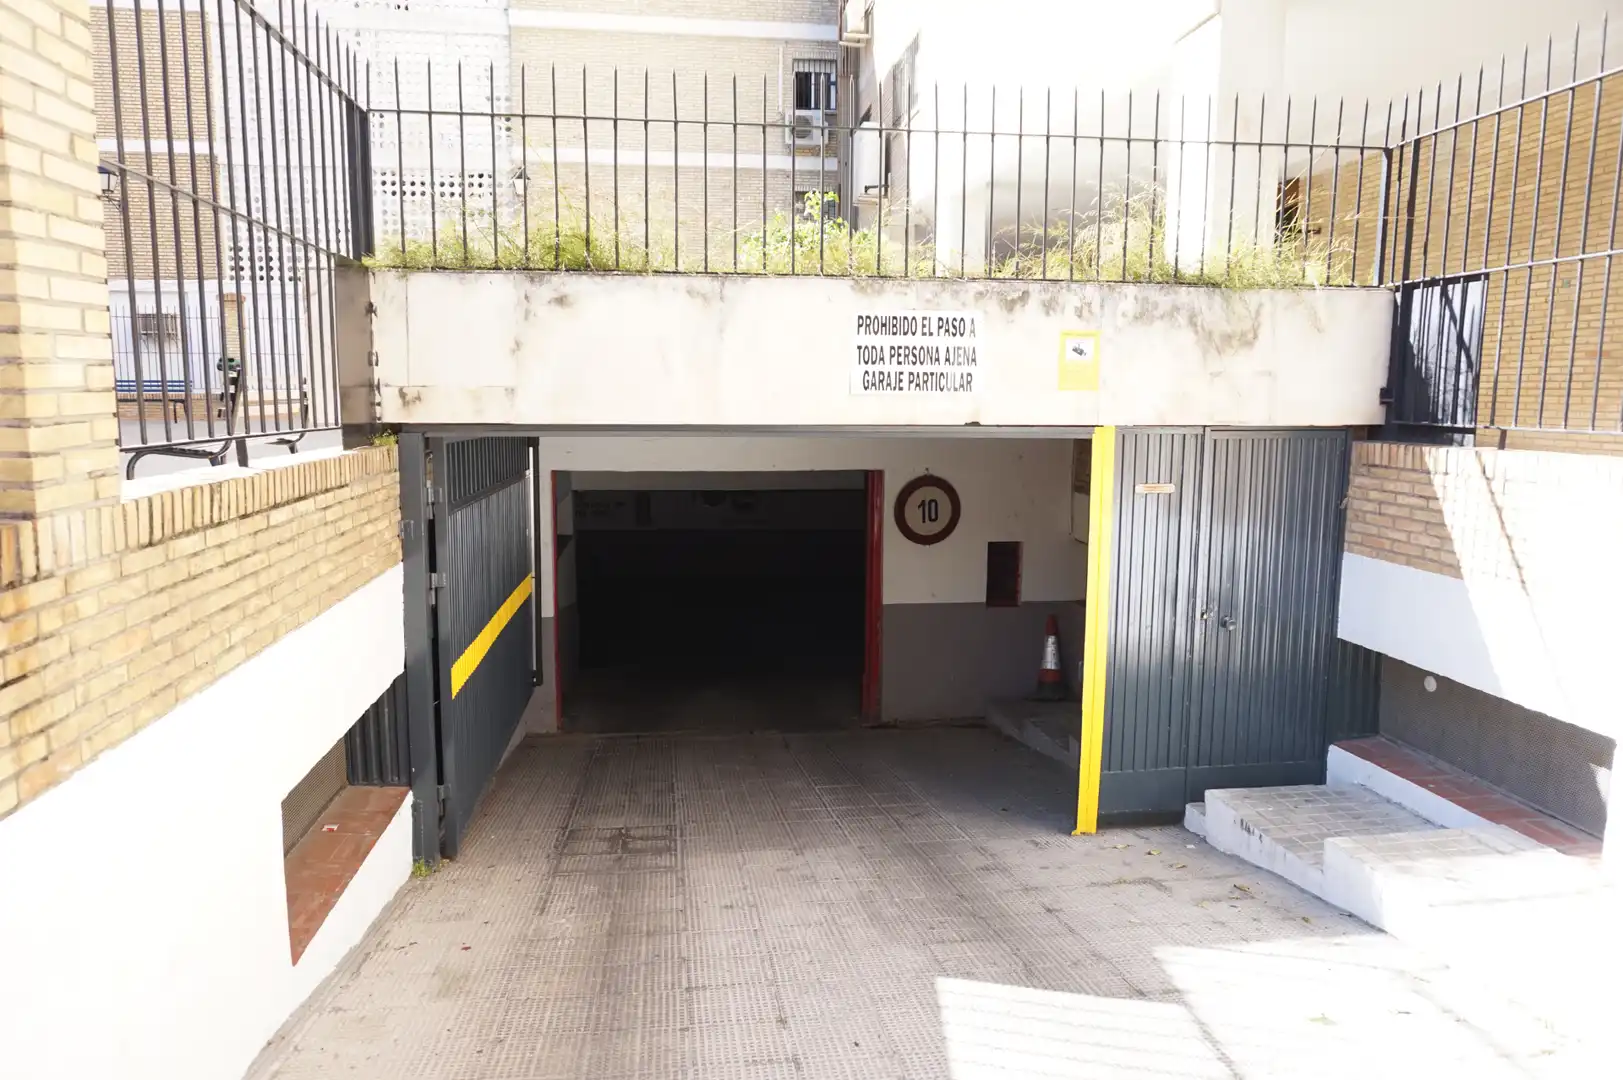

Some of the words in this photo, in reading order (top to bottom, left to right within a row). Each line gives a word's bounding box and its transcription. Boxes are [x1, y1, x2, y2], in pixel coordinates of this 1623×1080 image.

[857, 315, 918, 336] PROHIBIDO
[921, 316, 934, 337] EL
[937, 317, 966, 337] PASO
[969, 317, 976, 338] A
[857, 345, 885, 365] TODA
[889, 345, 941, 366] PERSONA
[944, 346, 977, 366] AJENA
[862, 370, 904, 391] GARAJE
[908, 371, 973, 392] PARTICULAR
[917, 498, 939, 523] 10
